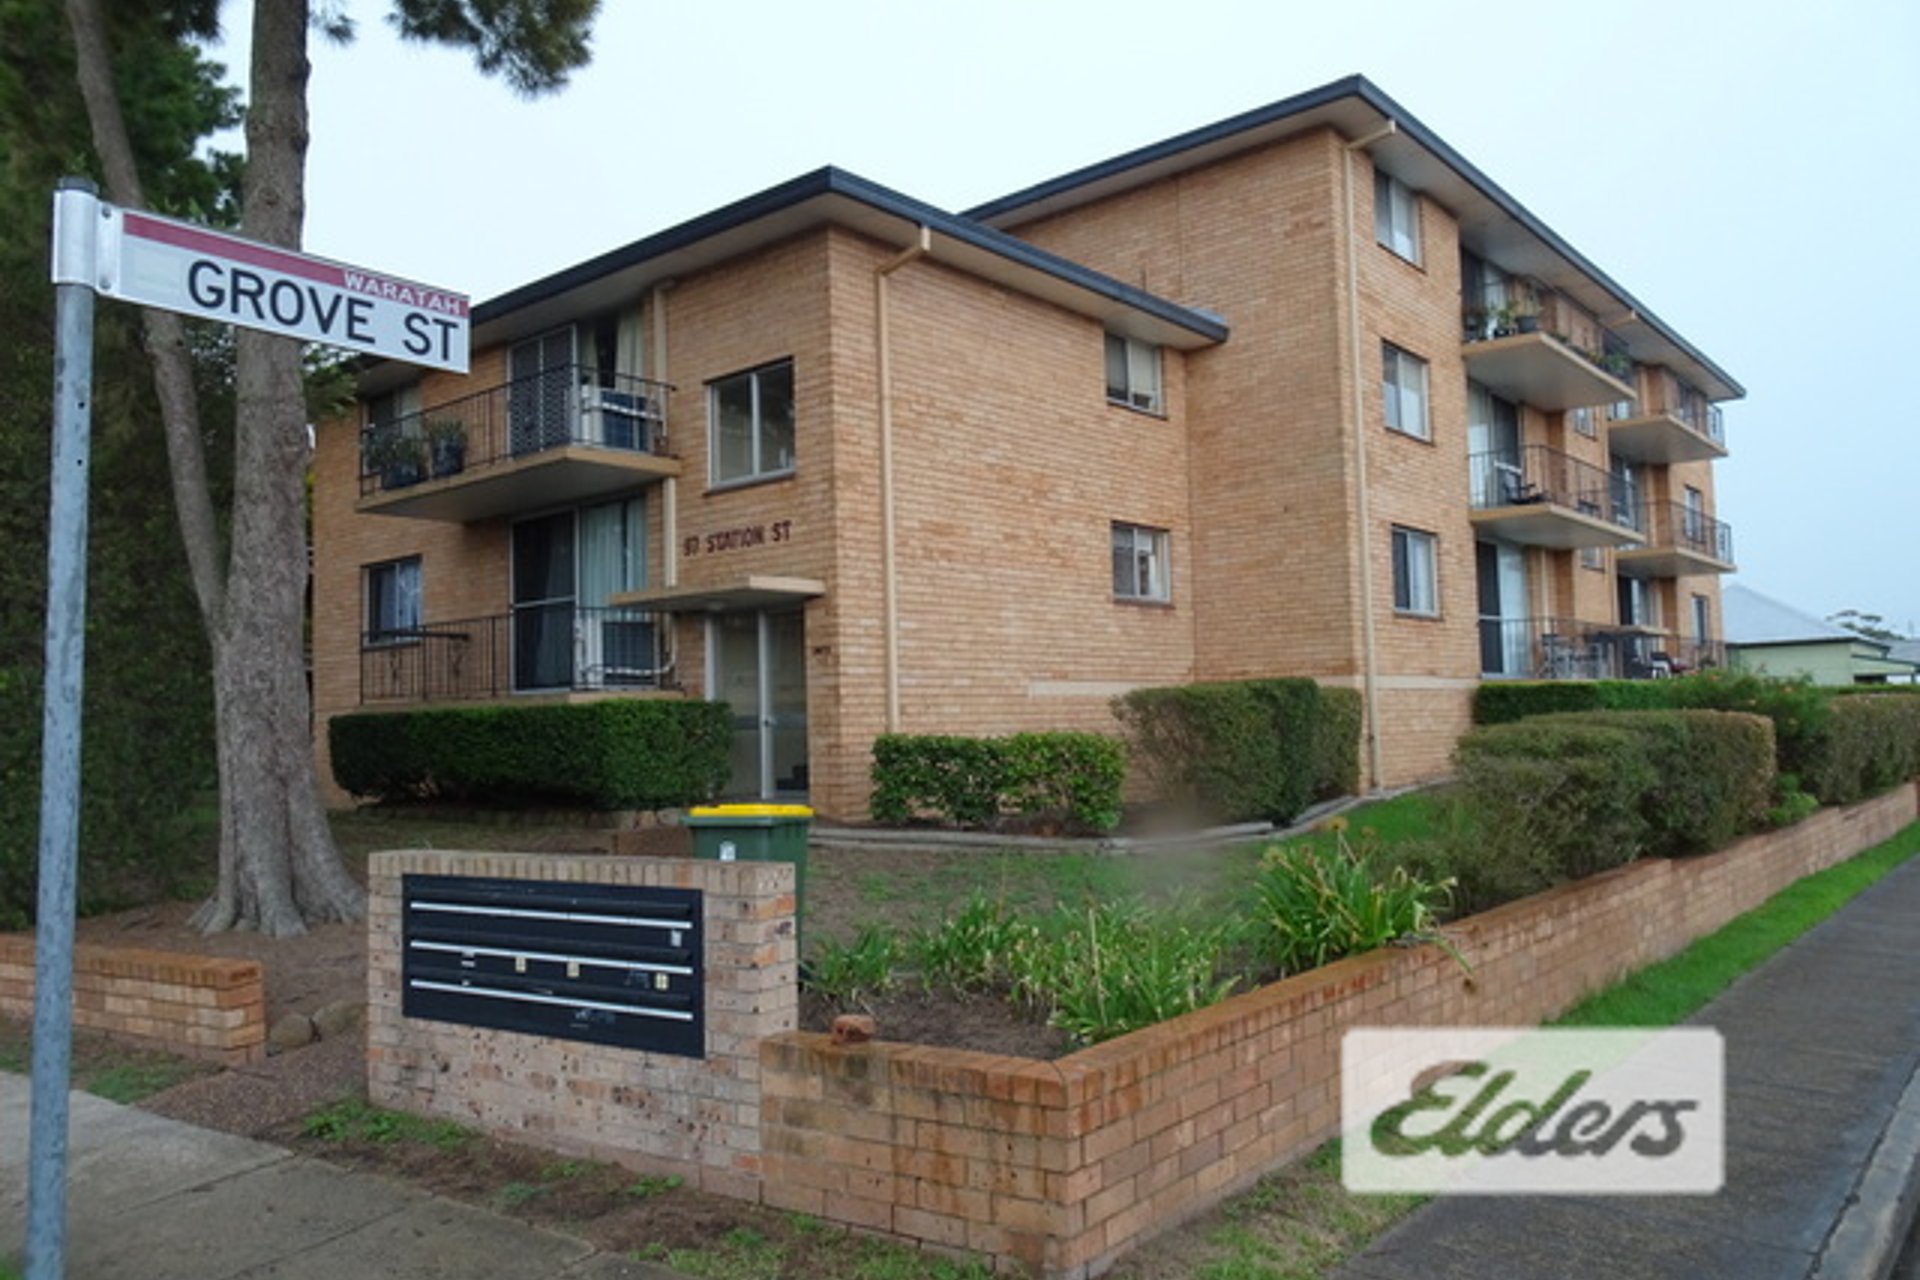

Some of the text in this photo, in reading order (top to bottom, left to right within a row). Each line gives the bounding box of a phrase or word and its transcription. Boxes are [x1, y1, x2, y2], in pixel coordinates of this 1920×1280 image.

[188, 260, 459, 361] GROVE ST
[344, 270, 460, 314] WARATAH
[772, 520, 792, 542] ST
